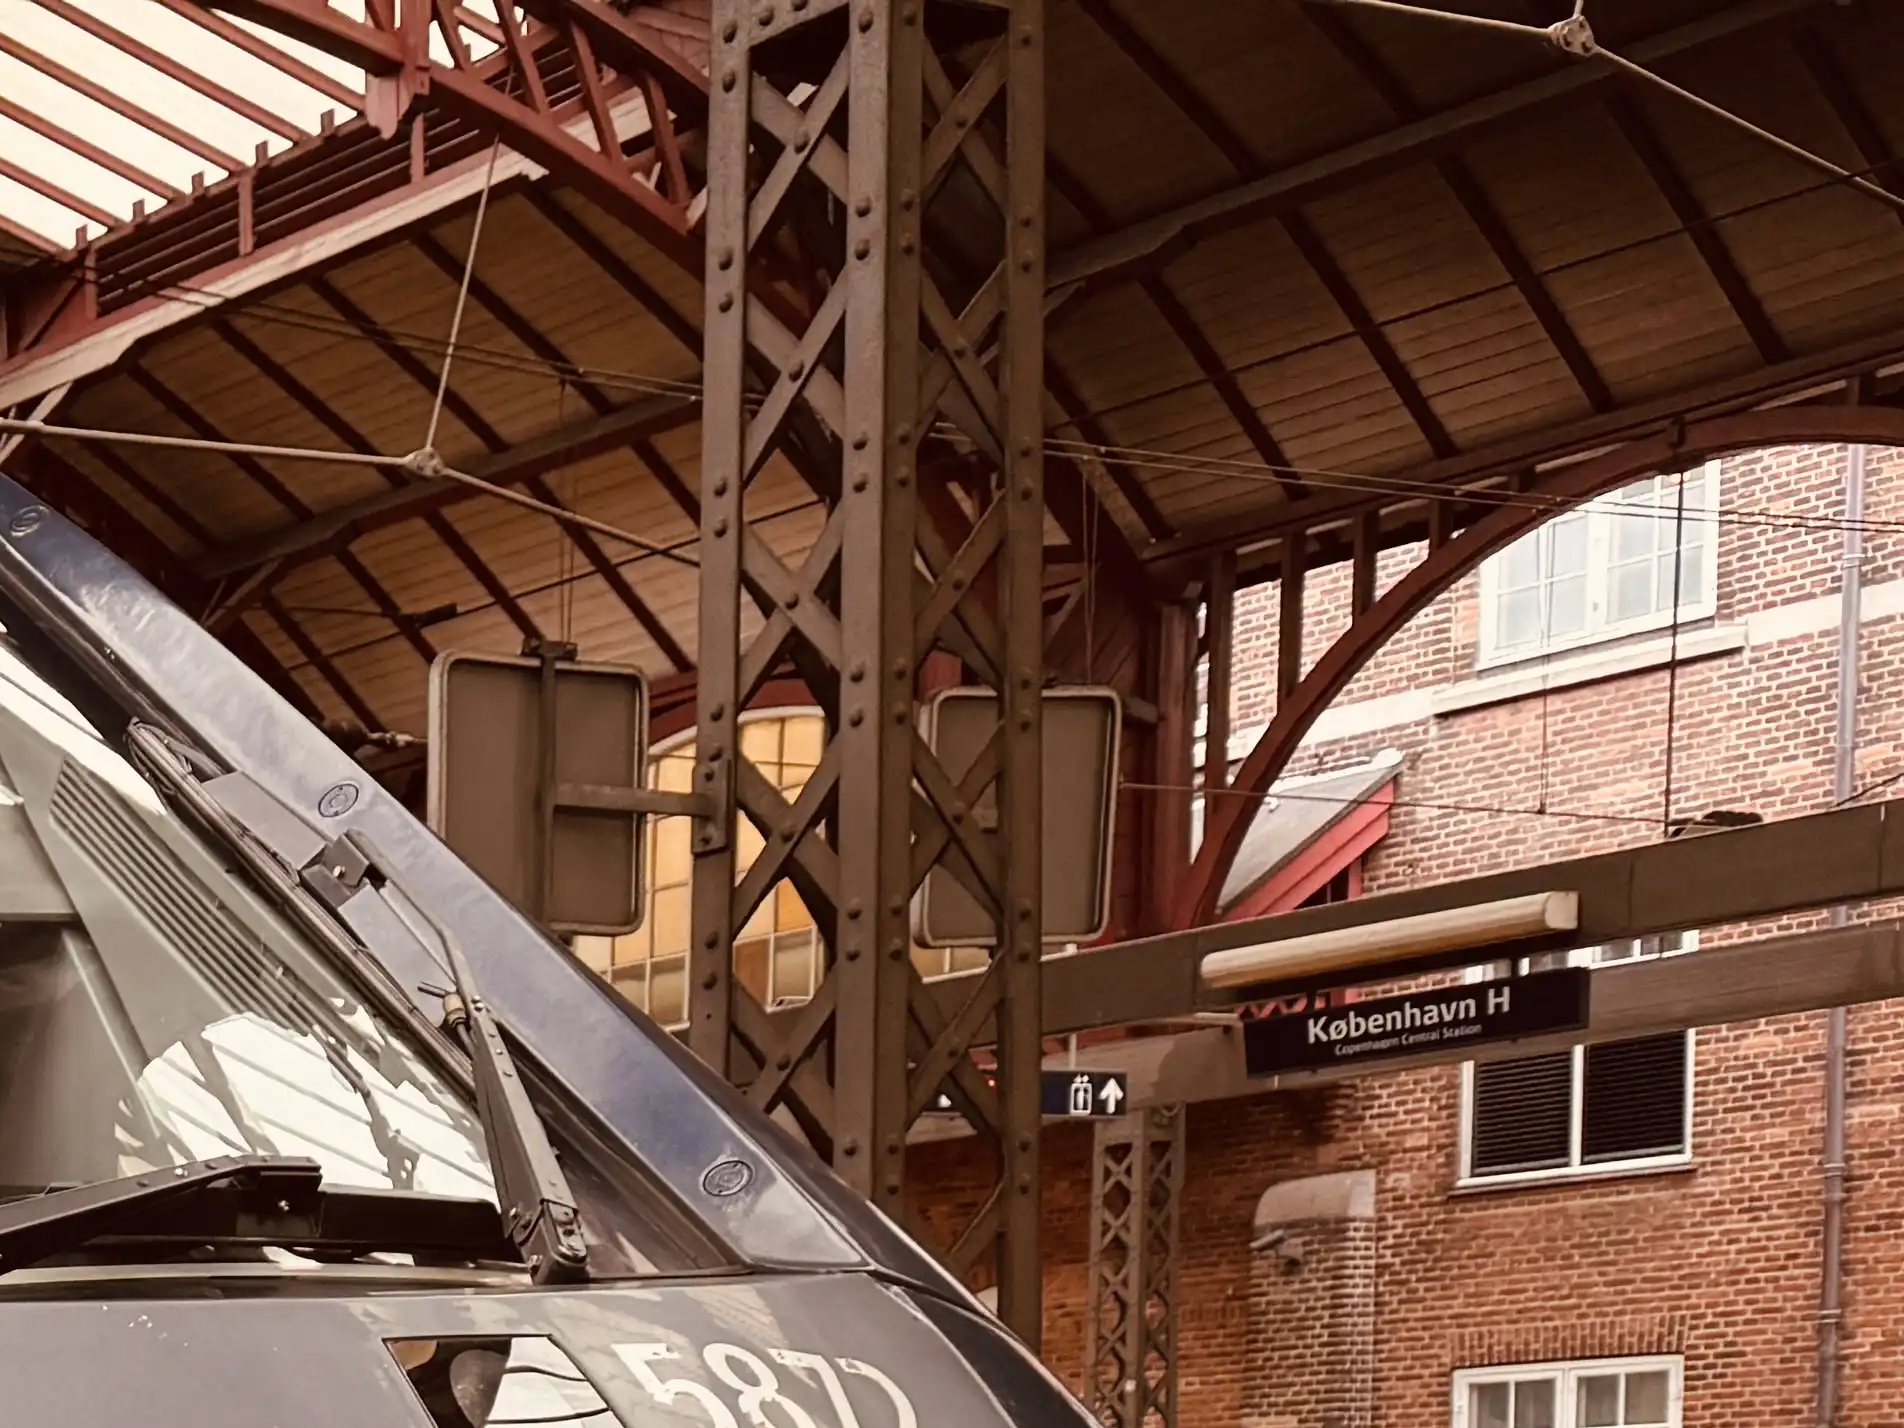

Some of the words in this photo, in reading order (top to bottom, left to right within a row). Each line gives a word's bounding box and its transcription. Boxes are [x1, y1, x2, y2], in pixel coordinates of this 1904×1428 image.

[1307, 998, 1476, 1044] København
[1486, 986, 1511, 1015] H
[1401, 1031, 1441, 1046] Central
[1442, 1023, 1482, 1040] Station
